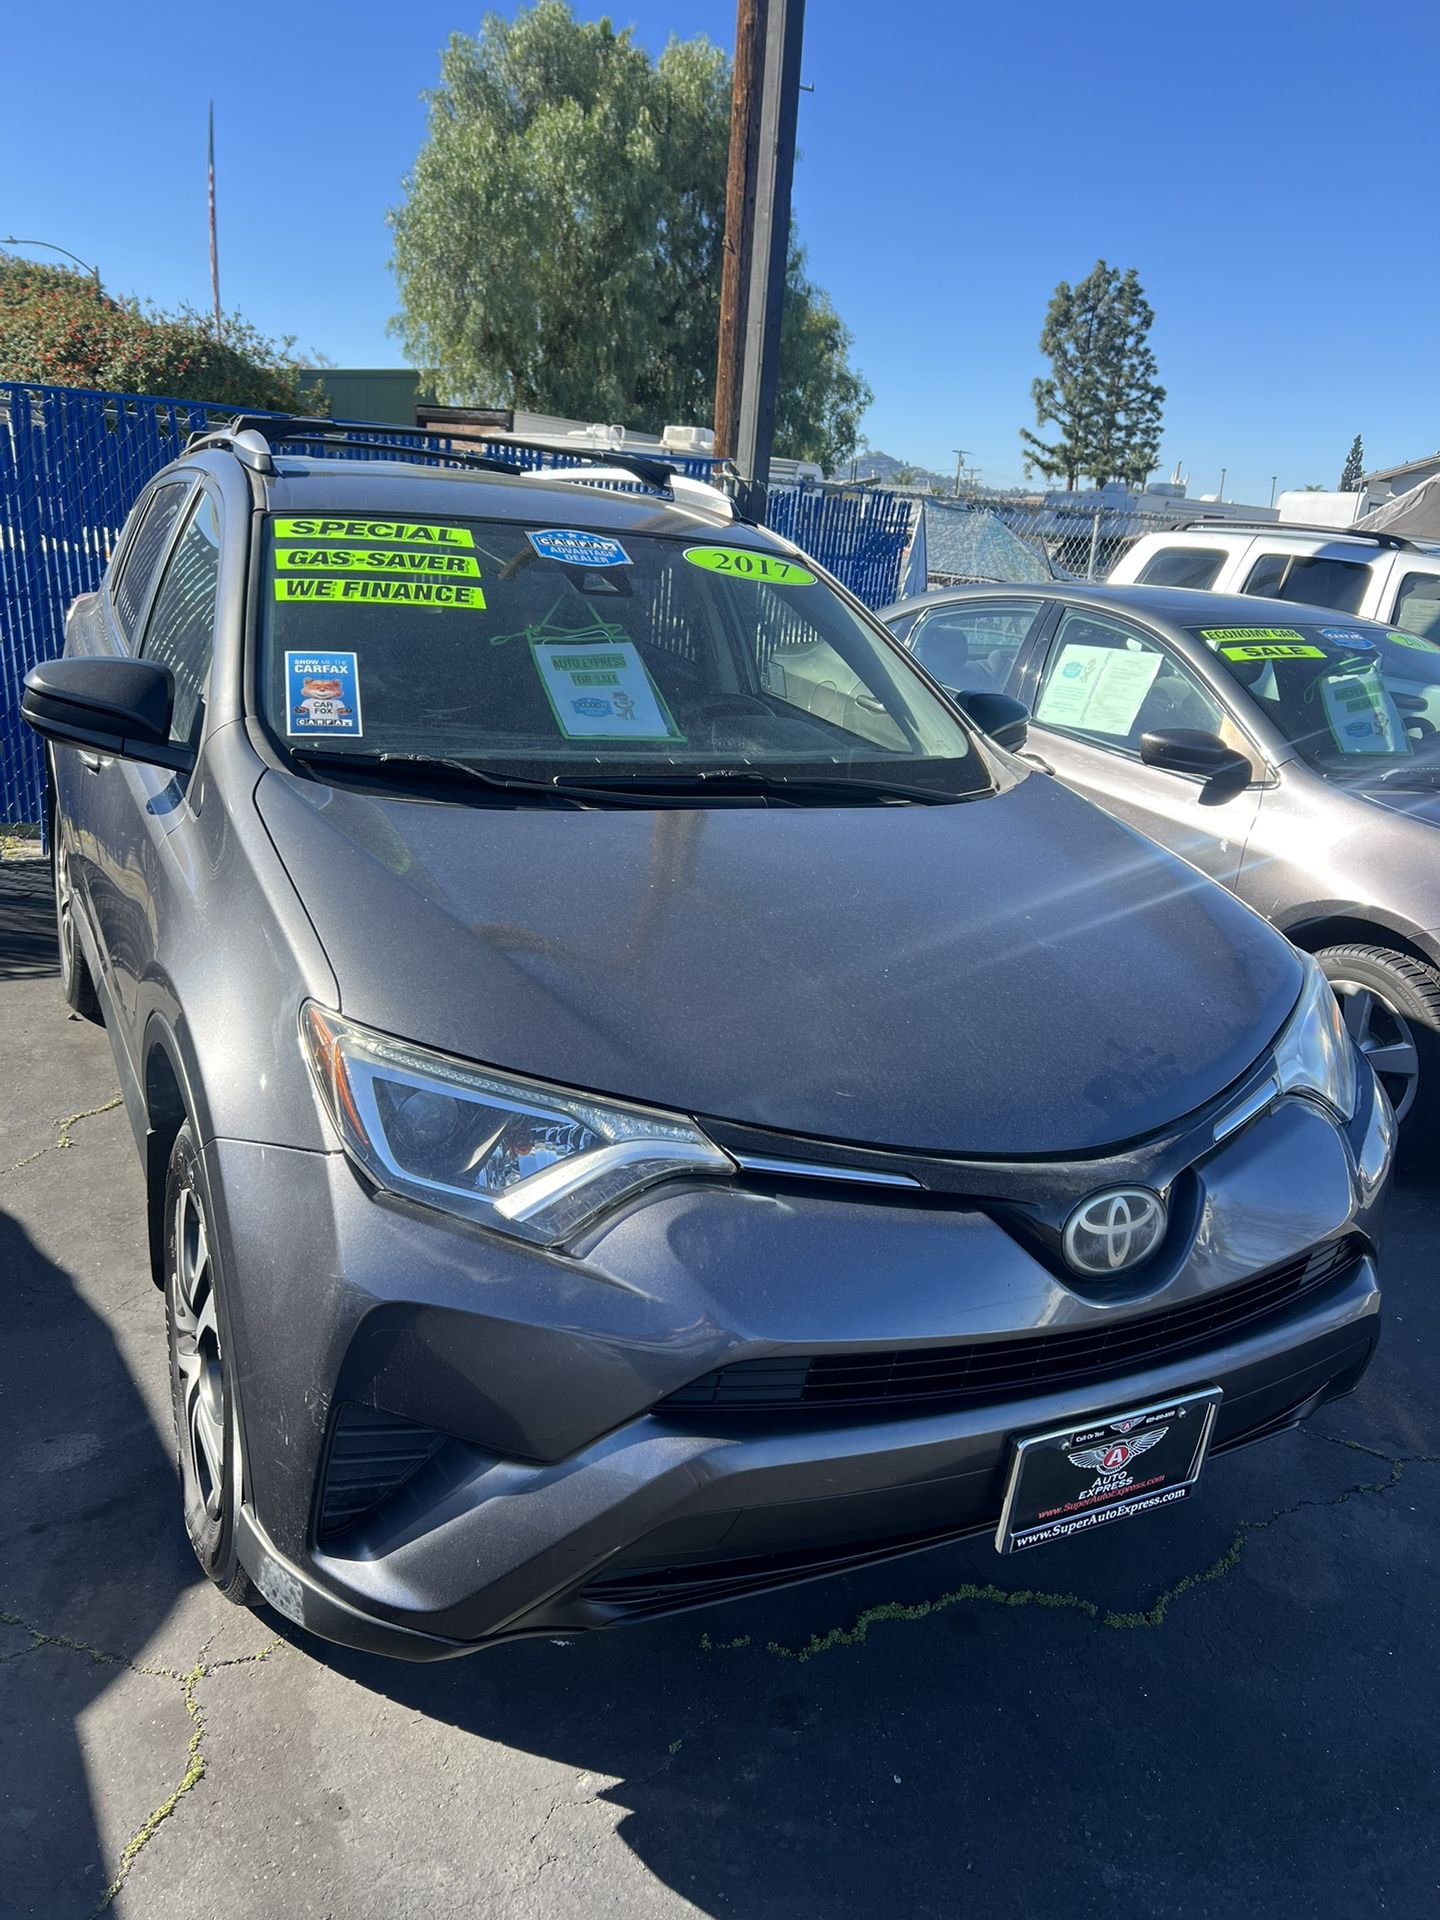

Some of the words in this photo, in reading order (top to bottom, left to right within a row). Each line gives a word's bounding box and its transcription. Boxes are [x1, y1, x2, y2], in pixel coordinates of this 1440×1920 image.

[289, 520, 463, 544] SPECIAL
[538, 537, 618, 551] CARFAX
[550, 546, 617, 558] ADVANTAGE
[287, 550, 470, 573] GAS-SAVER
[564, 554, 610, 564] DEALER
[712, 552, 790, 578] 2017
[286, 580, 337, 598] WE
[341, 581, 474, 604] FINANCE
[1205, 628, 1270, 640] ECONOMY
[1240, 646, 1310, 657] SALE
[294, 665, 349, 674] CARFAX
[552, 658, 580, 670] AUTO
[582, 655, 626, 669] EXPRESS
[571, 674, 593, 685] FOR
[595, 673, 618, 685] SALE
[296, 718, 353, 727] CARFAX
[1106, 1449, 1124, 1467] A
[1091, 1471, 1128, 1489] AUTO
[1078, 1477, 1134, 1500] EXPRESS
[1038, 1475, 1166, 1519] www.SuperAutoExpress.com
[1016, 1488, 1186, 1548] www.SuperAutoExpress.com
